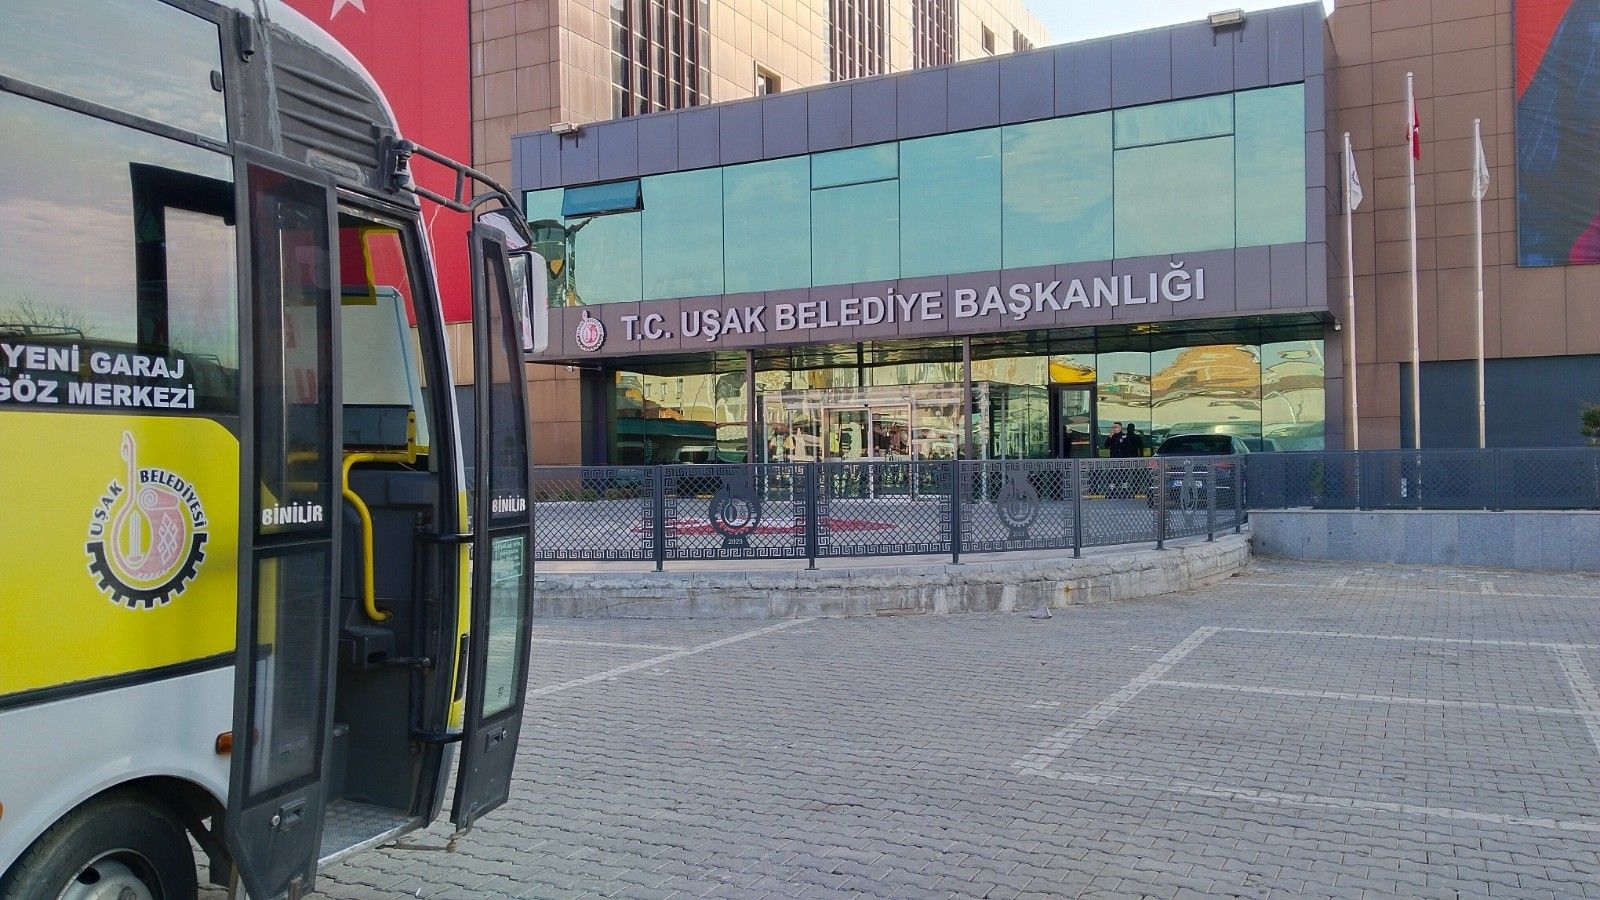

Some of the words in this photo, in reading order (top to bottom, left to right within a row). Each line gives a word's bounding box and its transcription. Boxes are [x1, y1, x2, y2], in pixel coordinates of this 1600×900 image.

[620, 315, 671, 341] T.C.
[681, 305, 766, 342] UŞAK
[775, 287, 943, 331] BELEDİYE
[955, 261, 1205, 320] BAŞKANLIĞI
[1, 343, 79, 372] YENİ
[90, 354, 185, 379] GARAJ
[68, 381, 195, 409] MERKEZİ
[90, 480, 123, 536] UŞAK
[139, 469, 207, 528] BELEDİYESİ
[262, 501, 323, 525] BİNİLİR
[492, 494, 526, 513] BİNİLİR
